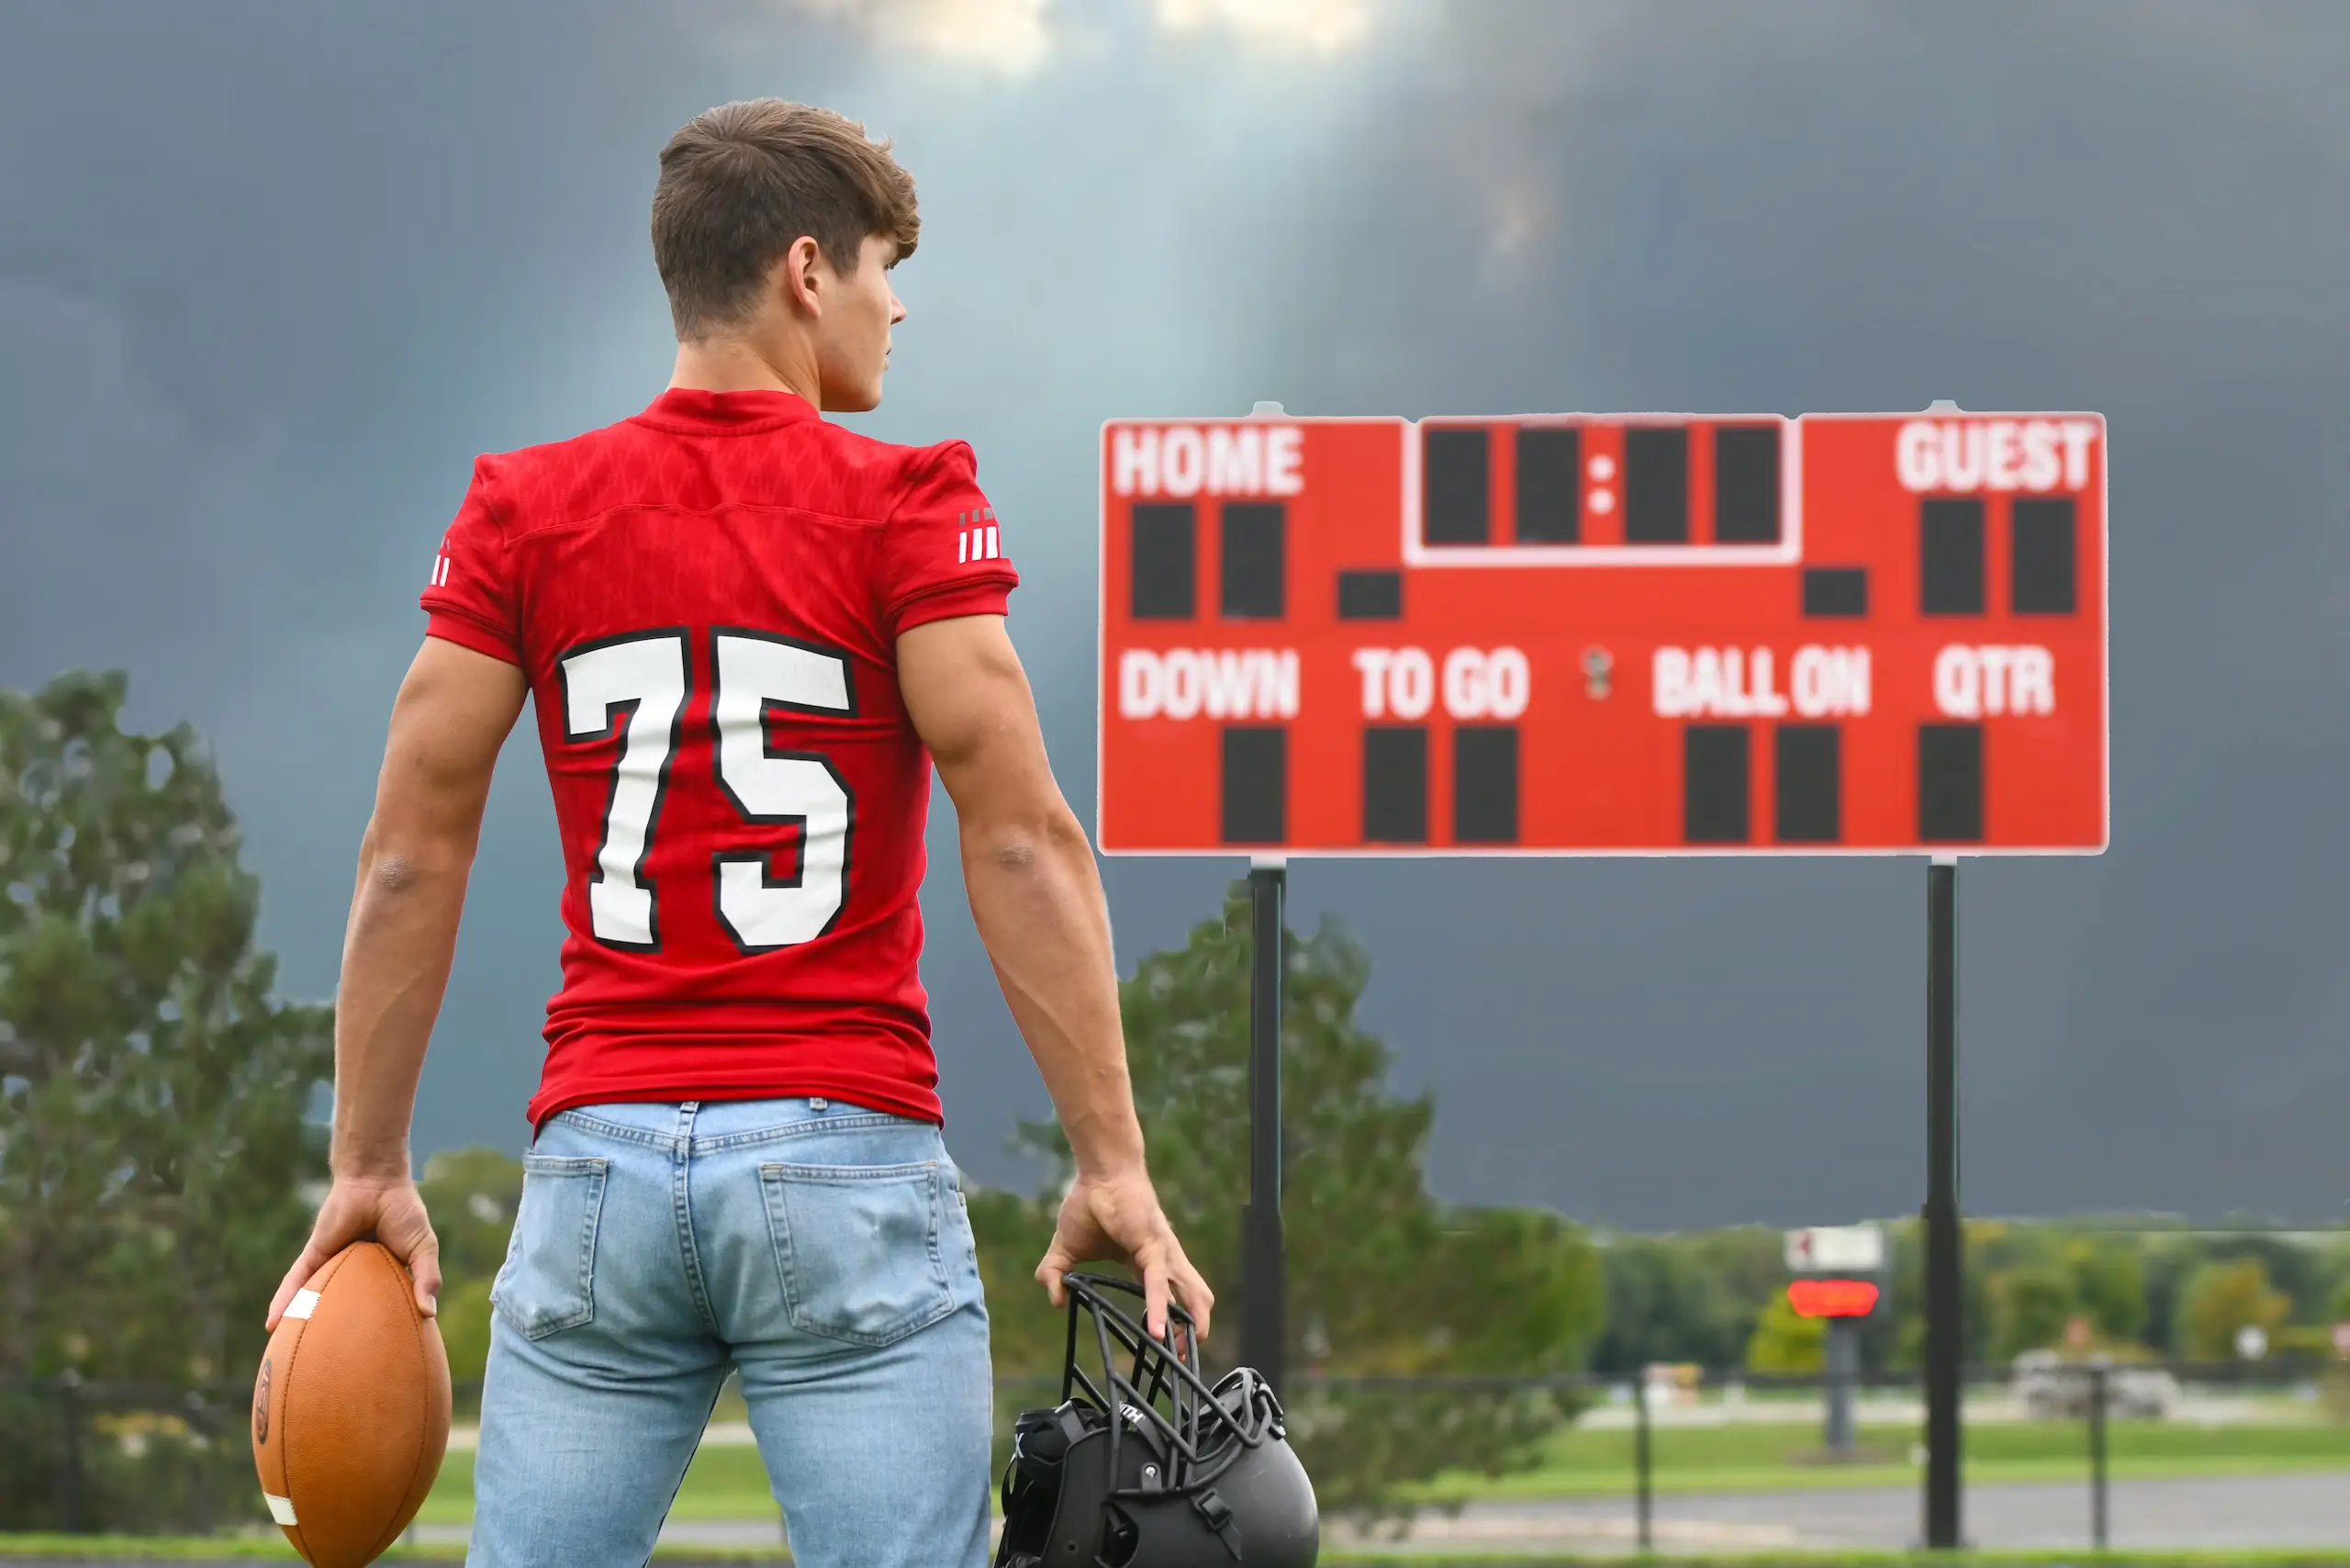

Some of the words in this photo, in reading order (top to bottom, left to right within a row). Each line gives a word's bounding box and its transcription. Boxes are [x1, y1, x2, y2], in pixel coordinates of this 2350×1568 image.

[1113, 426, 1304, 496] HOME
[1895, 420, 2097, 491] GUEST
[1119, 647, 1300, 720] DOWN
[1352, 646, 1434, 719] TO
[1442, 646, 1530, 719] GO
[1652, 645, 1788, 717] BALL
[1791, 644, 1871, 717] ON
[1933, 644, 2055, 720] QTR
[556, 626, 857, 955] 75
